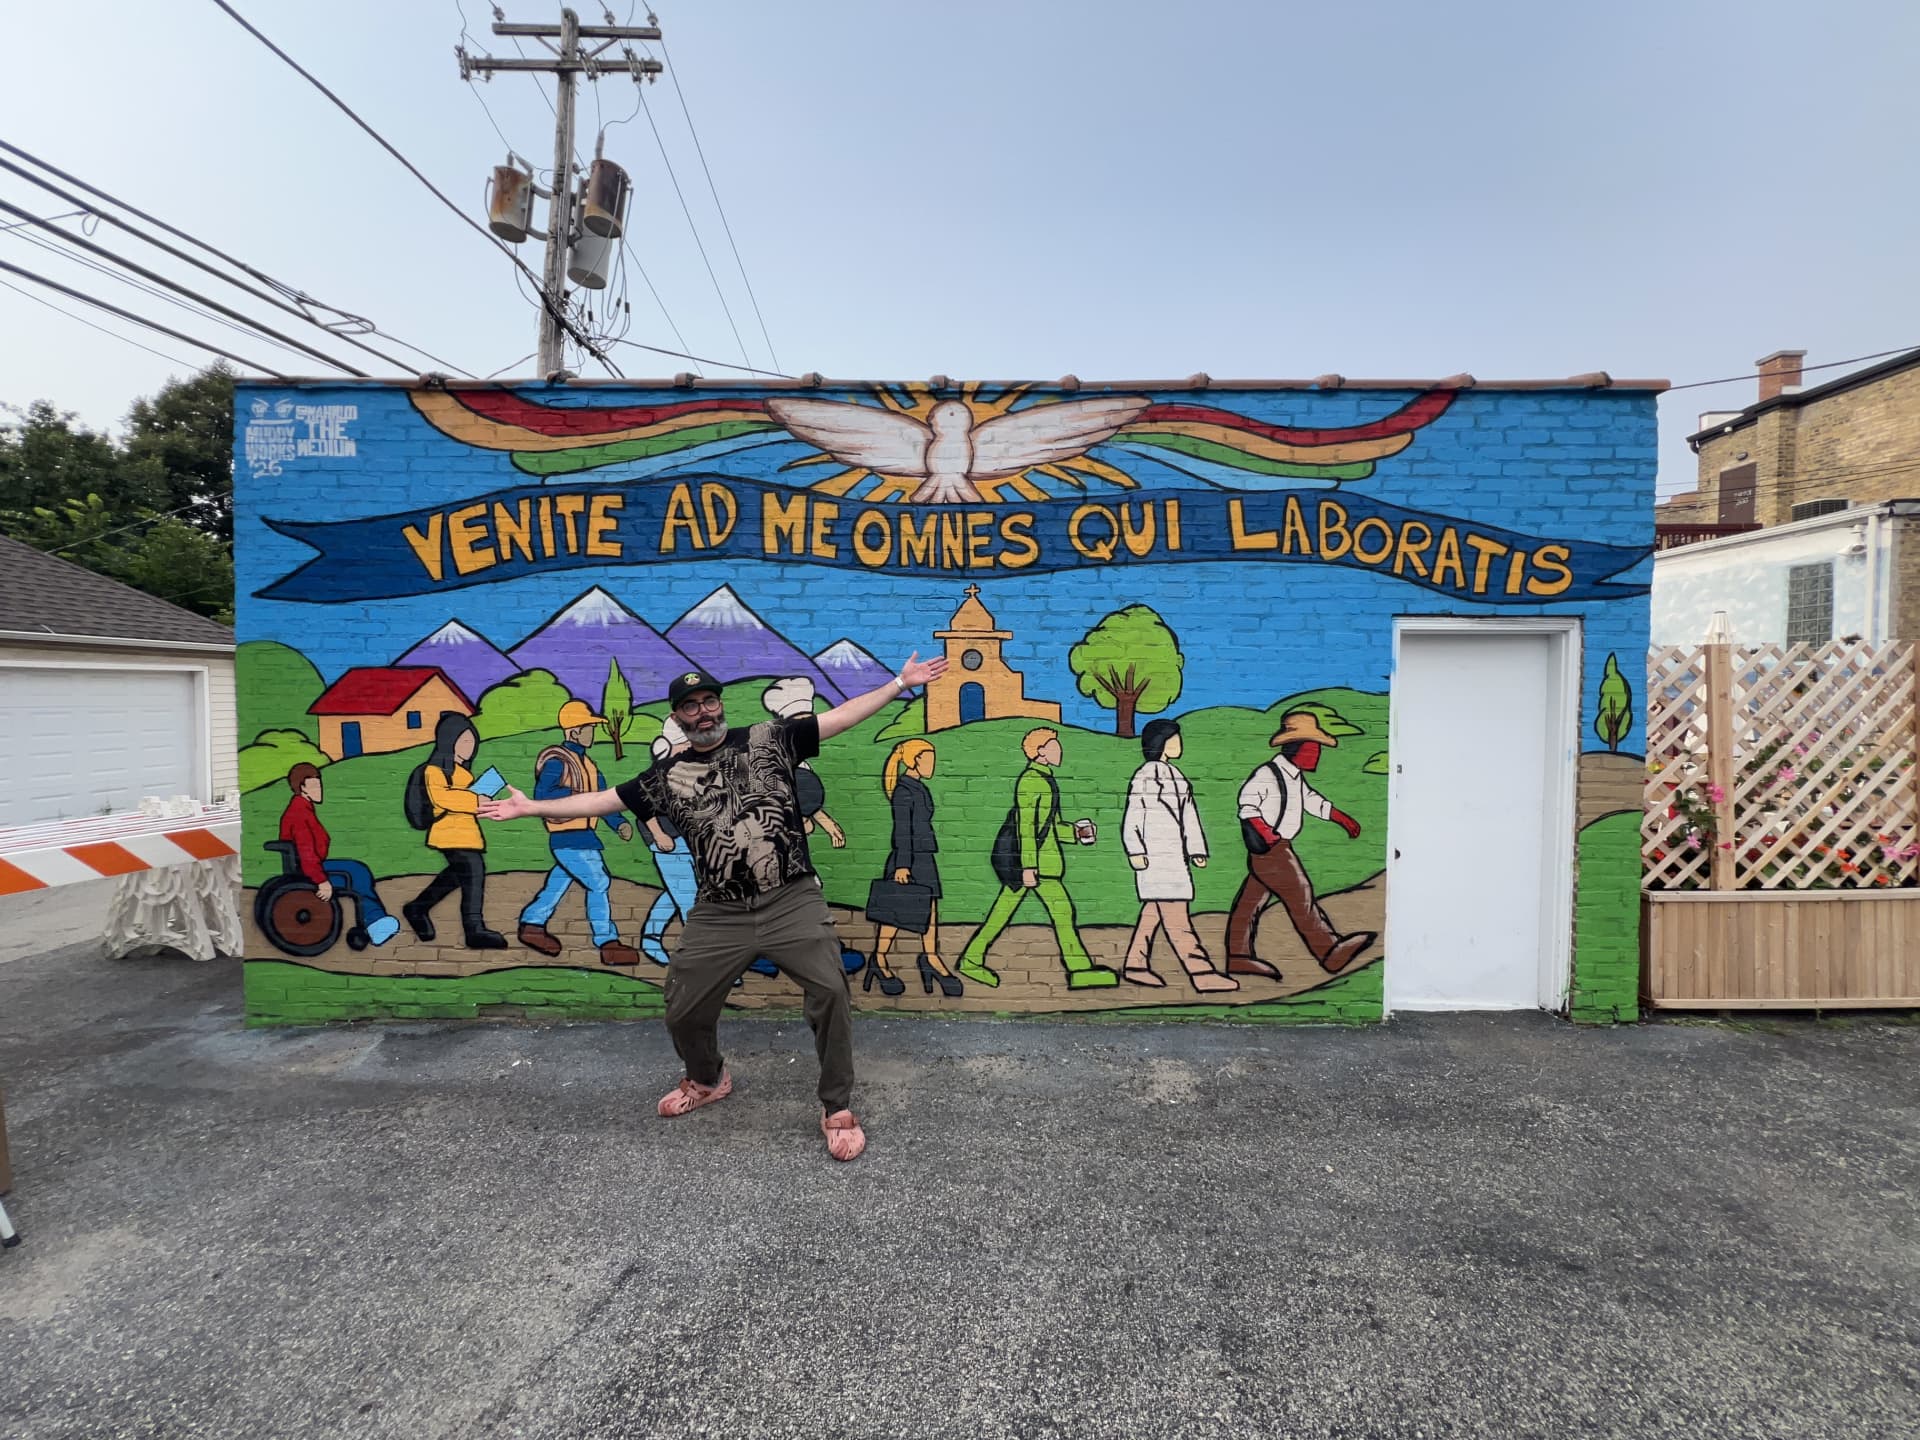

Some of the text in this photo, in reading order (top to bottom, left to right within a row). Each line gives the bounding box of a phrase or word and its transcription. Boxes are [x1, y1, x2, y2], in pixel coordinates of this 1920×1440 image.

[245, 426, 295, 443] MUDDY
[304, 417, 349, 439] THE
[245, 444, 296, 460] WORKS
[297, 439, 357, 456] MEDIUM
[403, 483, 1573, 595] VENITE AD ME OMNES QUI LABORATIS
